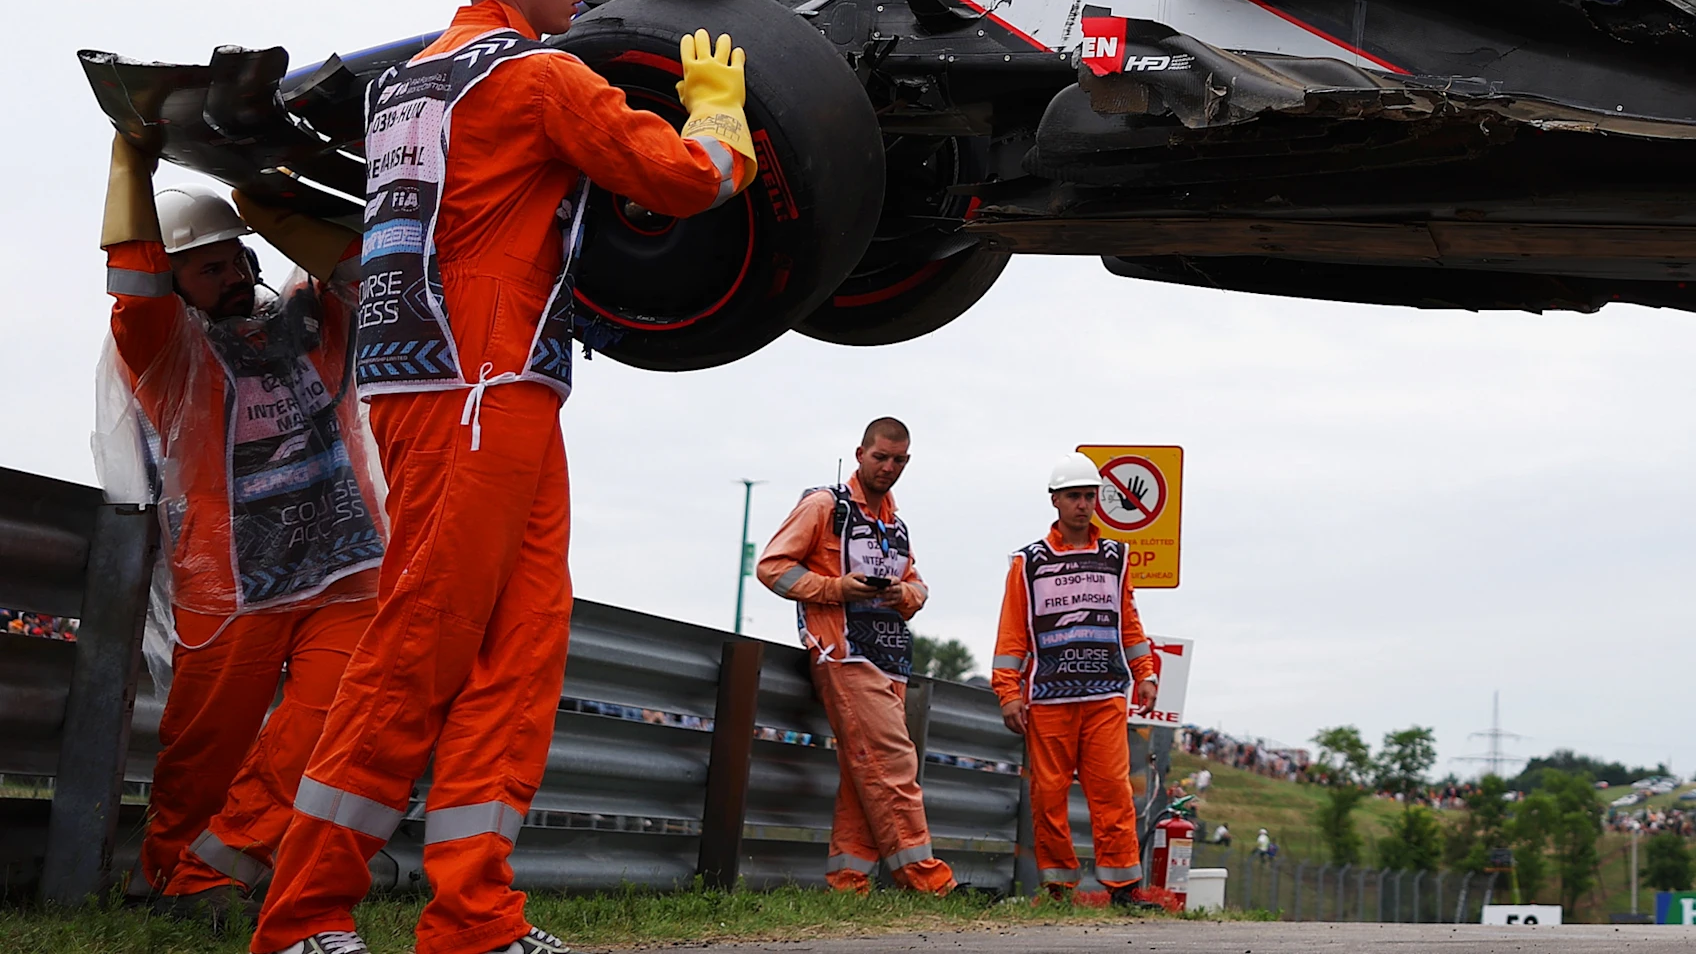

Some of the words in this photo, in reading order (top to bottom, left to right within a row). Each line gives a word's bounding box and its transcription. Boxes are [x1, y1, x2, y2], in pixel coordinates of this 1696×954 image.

[391, 190, 419, 209] FIA
[359, 271, 403, 306] OURSE
[1127, 551, 1156, 567] OP
[1055, 573, 1106, 587] 0390-HUN
[1045, 596, 1069, 608] FIRE
[1071, 593, 1113, 606] MARSHA
[1056, 660, 1109, 674] ACCESS
